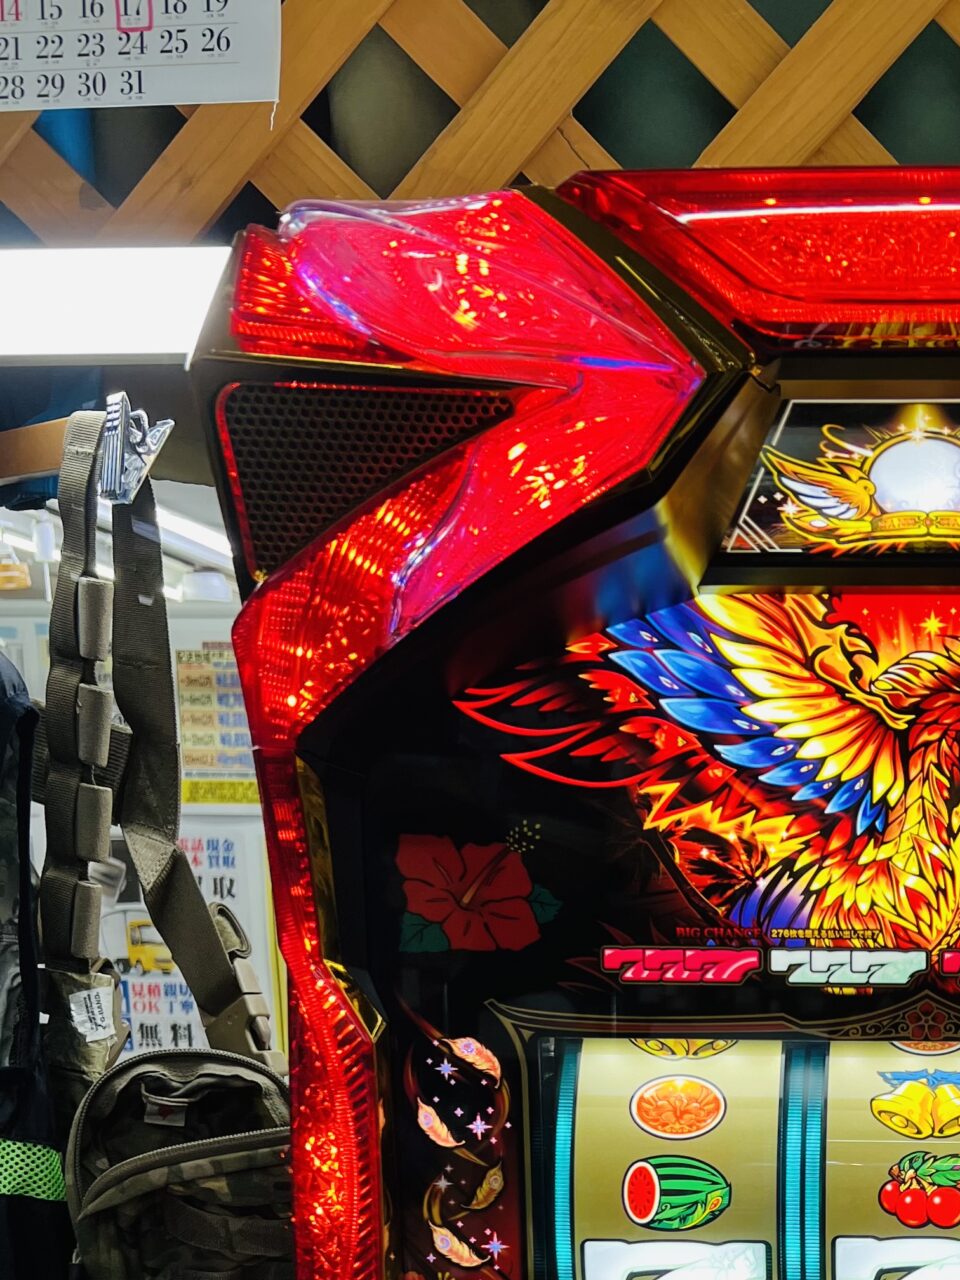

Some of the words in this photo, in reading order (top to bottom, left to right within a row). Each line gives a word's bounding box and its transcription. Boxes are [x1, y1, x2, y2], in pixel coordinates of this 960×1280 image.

[0, 0, 22, 21] 14
[37, 0, 63, 20] 15
[79, 0, 105, 18] 16
[120, 0, 144, 17] 17
[161, 0, 187, 15] 18
[0, 37, 21, 60] 21
[36, 35, 63, 59] 22
[77, 33, 105, 57] 23
[118, 31, 148, 56] 24
[160, 29, 189, 54] 25
[201, 27, 231, 52] 26
[0, 75, 25, 99] 28
[36, 74, 65, 97] 29
[78, 72, 106, 97] 30
[120, 70, 147, 95] 31
[676, 927, 699, 937] BIG
[704, 927, 762, 938] CHANCE
[133, 1000, 160, 1013] OK
